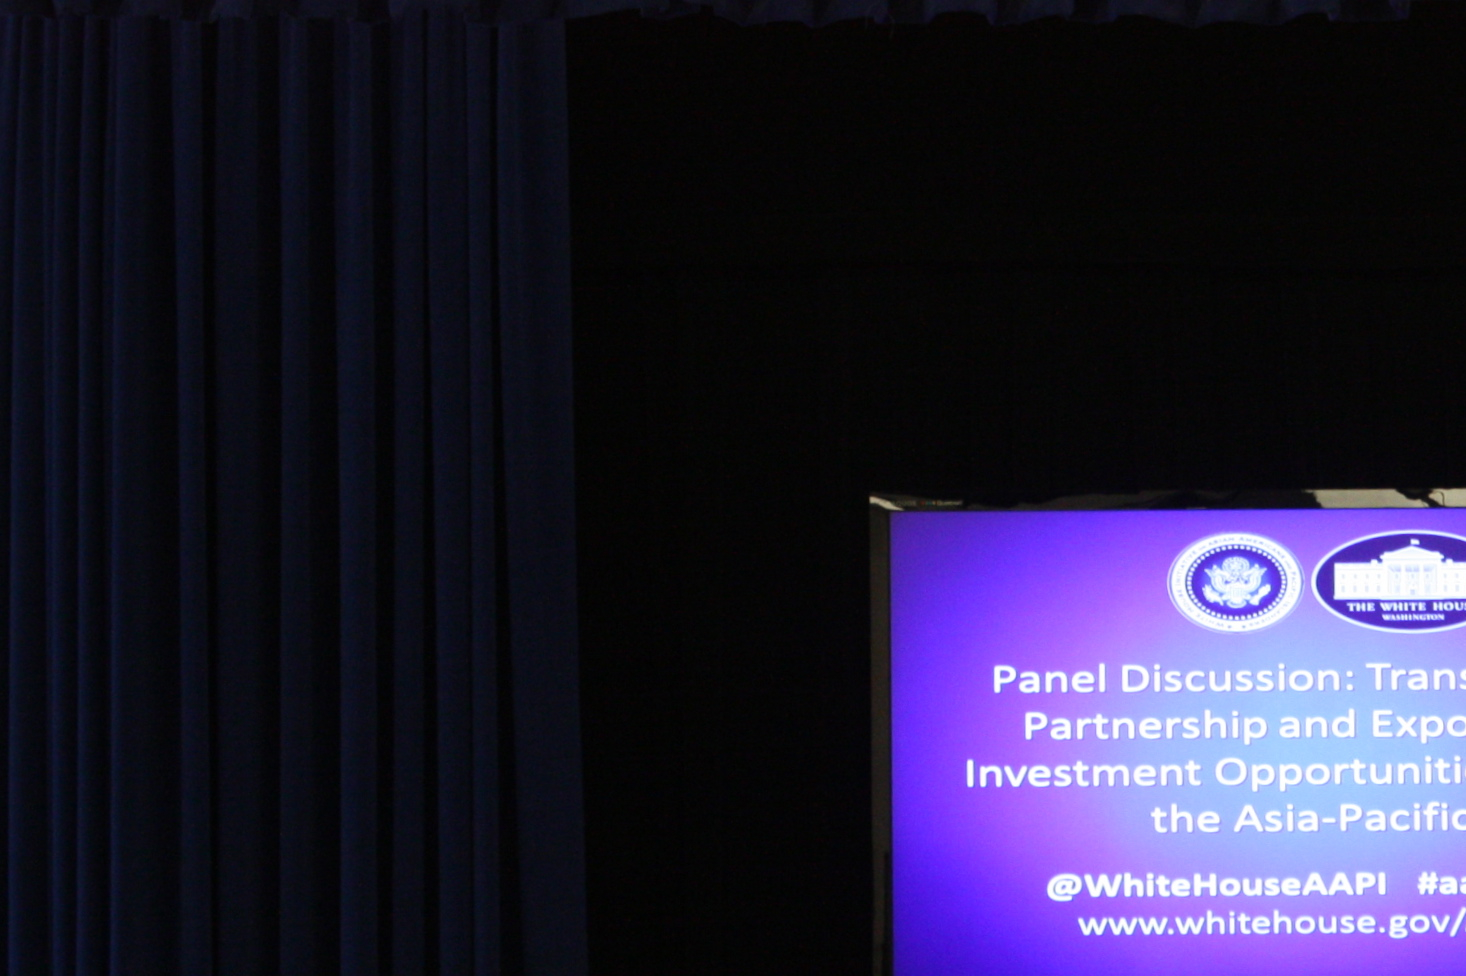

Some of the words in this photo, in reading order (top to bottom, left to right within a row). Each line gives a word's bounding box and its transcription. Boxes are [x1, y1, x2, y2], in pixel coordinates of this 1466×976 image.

[1347, 601, 1376, 612] THE
[1380, 601, 1427, 612] WHITE
[1382, 613, 1445, 622] WASHINGTON
[993, 663, 1106, 694] Panel
[1121, 663, 1353, 693] Discussion:
[1024, 709, 1267, 746] Partnership
[1279, 708, 1355, 738] and
[965, 758, 1201, 789] Investment
[1151, 804, 1220, 834] the
[1046, 871, 1387, 903] @WhiteHouseAAPI
